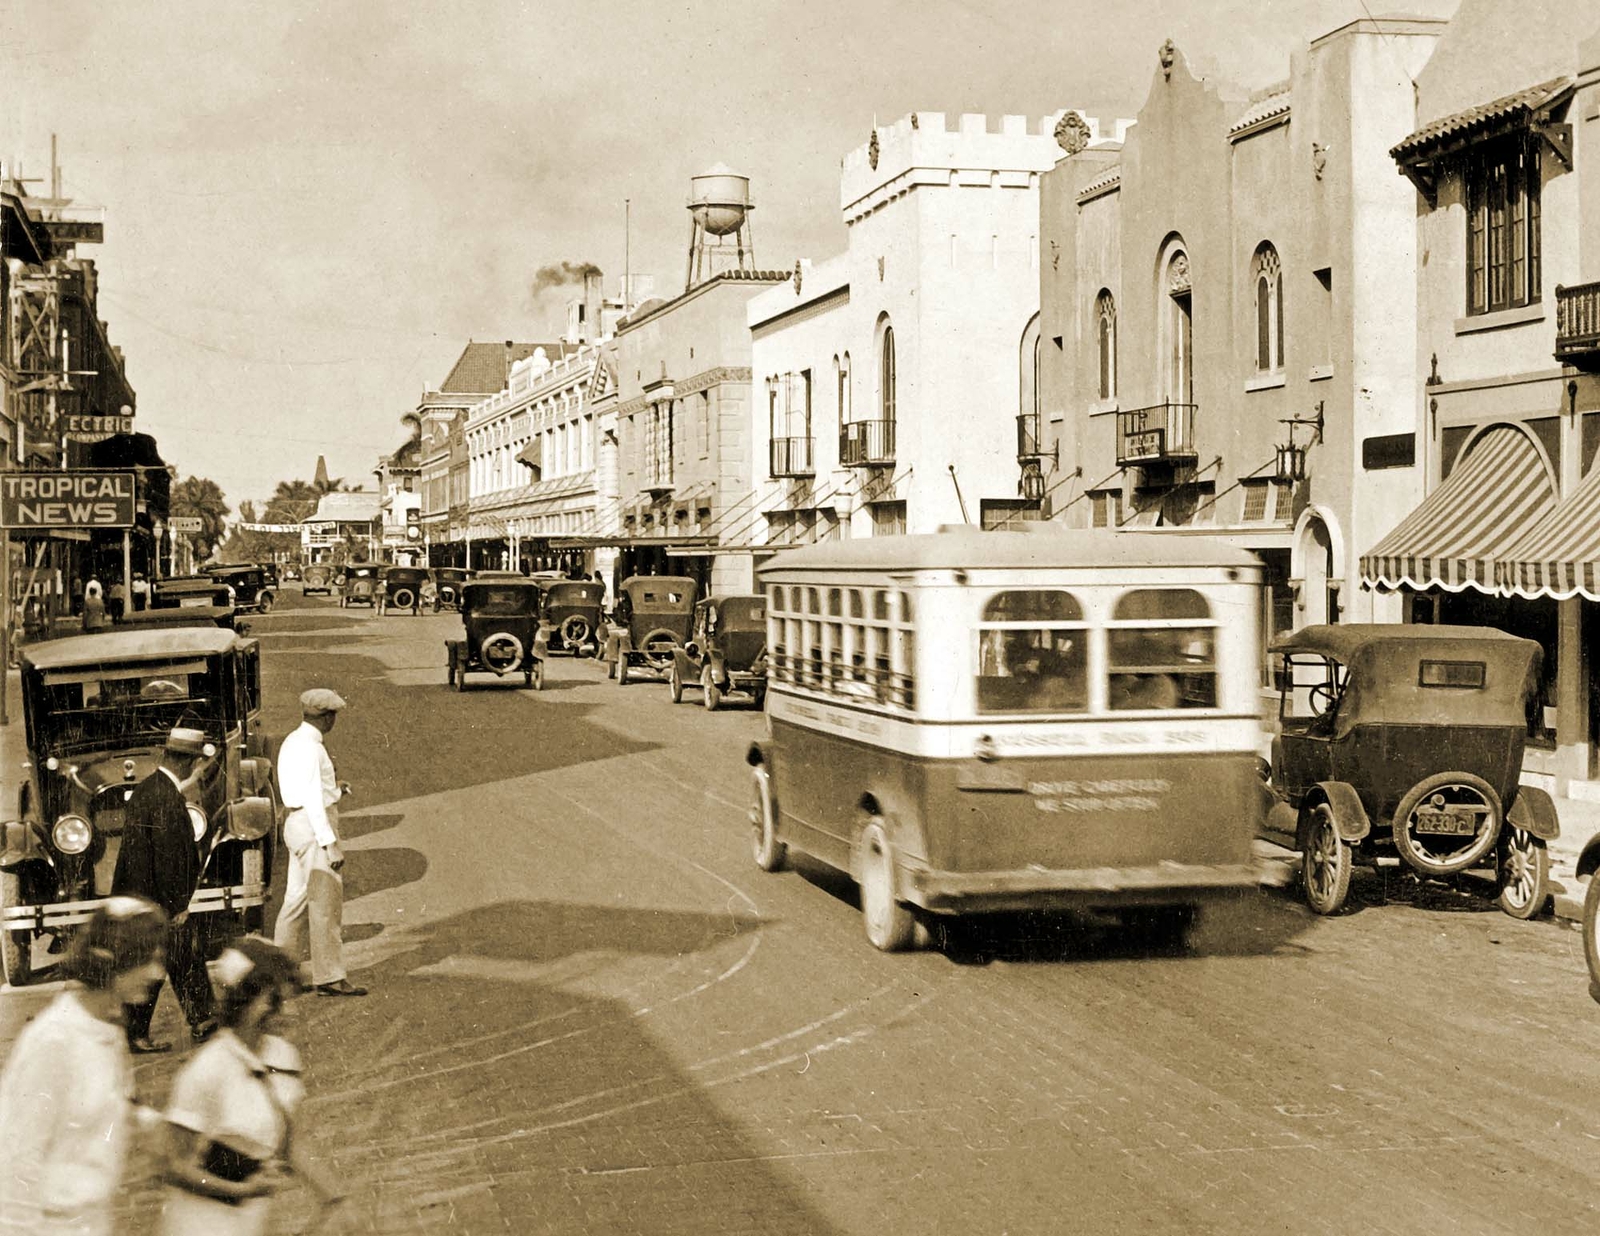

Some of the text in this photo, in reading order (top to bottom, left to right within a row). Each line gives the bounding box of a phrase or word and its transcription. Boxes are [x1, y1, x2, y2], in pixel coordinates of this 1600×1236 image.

[66, 415, 132, 432] ECTRIC
[5, 477, 131, 498] TROPICAL
[18, 503, 118, 523] NEWS
